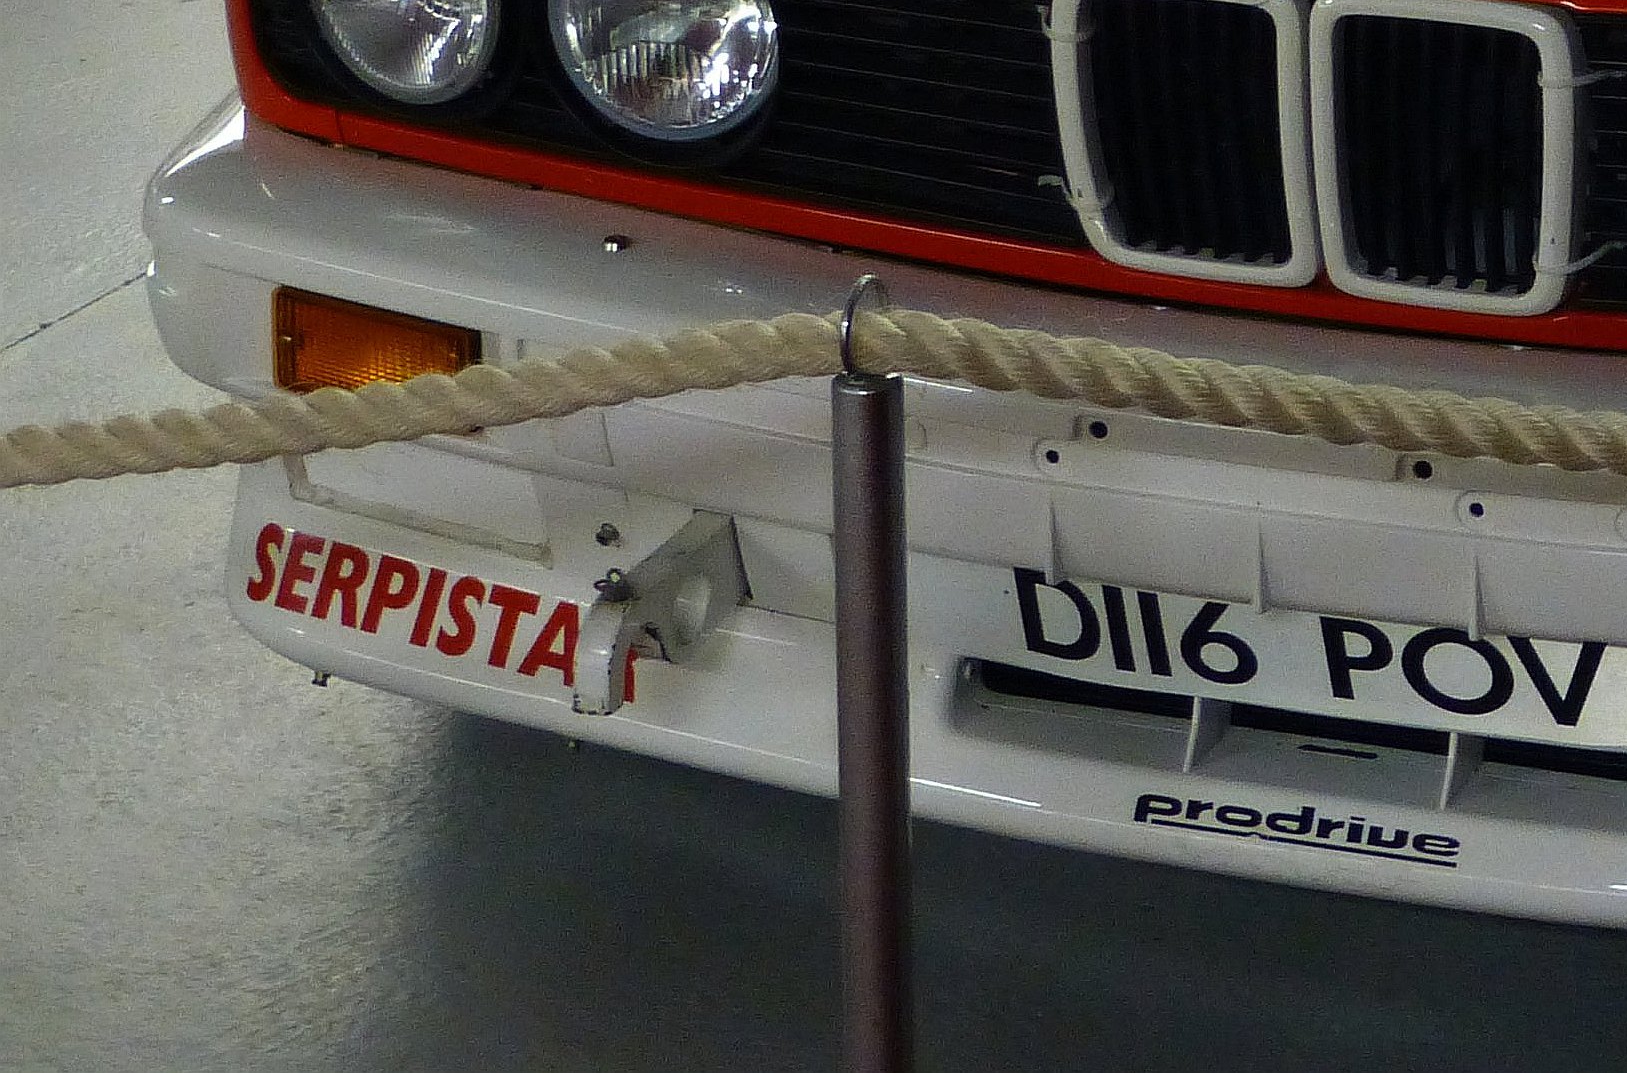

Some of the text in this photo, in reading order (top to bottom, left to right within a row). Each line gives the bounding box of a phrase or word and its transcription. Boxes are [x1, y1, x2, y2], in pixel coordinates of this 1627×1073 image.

[246, 522, 638, 704] SERPISTA
[1012, 567, 1609, 727] D116 POV
[1134, 793, 1462, 859] prodrive
